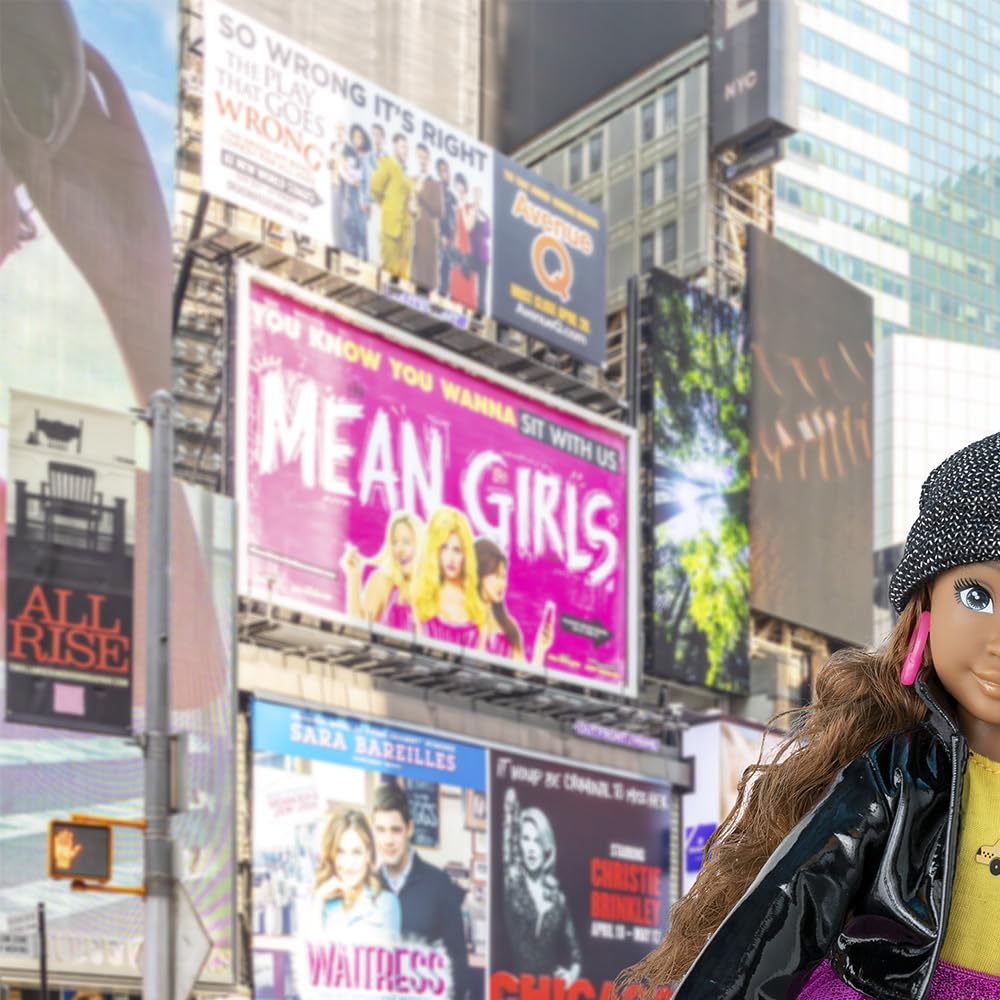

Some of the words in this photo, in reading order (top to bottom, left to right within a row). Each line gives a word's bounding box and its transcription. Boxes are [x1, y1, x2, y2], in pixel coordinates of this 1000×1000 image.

[219, 13, 257, 50] SO
[265, 35, 367, 108] WRONG
[374, 97, 415, 135] IT'S
[422, 119, 488, 172] RIGHT
[264, 64, 317, 108] PLAY
[214, 89, 324, 172] WRONG
[264, 91, 325, 138] GOES
[511, 188, 594, 256] Avenue
[530, 231, 574, 303] Q
[250, 299, 299, 342] YOU
[309, 326, 380, 372] KNOW
[389, 359, 434, 394] YOU
[441, 380, 517, 427] WANNA
[520, 412, 545, 442] SIT
[549, 421, 593, 462] WITH
[595, 443, 618, 472] US
[258, 370, 444, 521] MEAN
[461, 450, 620, 588] GIRLS
[19, 585, 122, 635] ALL
[8, 618, 130, 673] RISE
[290, 722, 348, 752] SARA
[355, 735, 457, 773] BAREILLES
[591, 857, 662, 897] CHRISTIE
[591, 891, 662, 928] BRINKLEY
[306, 940, 446, 996] WAITRESS
